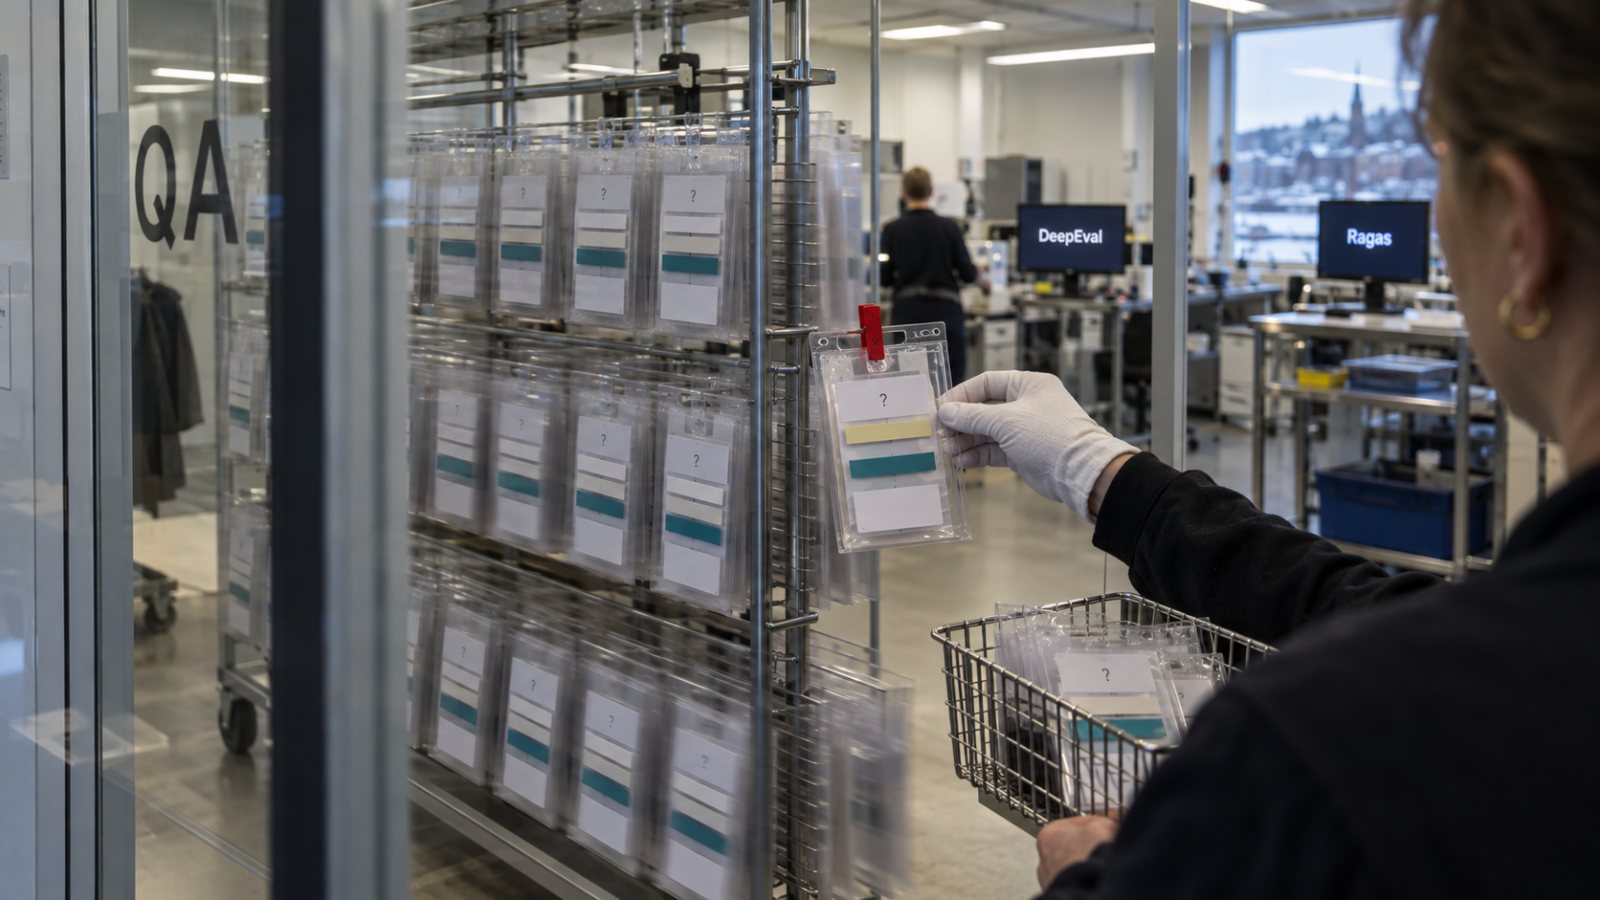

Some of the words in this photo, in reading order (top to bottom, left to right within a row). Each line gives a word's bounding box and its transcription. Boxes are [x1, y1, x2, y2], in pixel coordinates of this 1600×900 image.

[135, 119, 239, 250] QA
[601, 187, 607, 200] ?
[690, 188, 697, 203] ?
[1038, 228, 1103, 246] DeepEval
[1346, 228, 1393, 249] Ragas
[879, 393, 888, 407] ?
[601, 433, 607, 446] ?
[693, 454, 700, 468] ?
[460, 645, 467, 659] ?
[1102, 667, 1110, 682] ?
[531, 679, 537, 692] ?
[608, 714, 615, 729] ?
